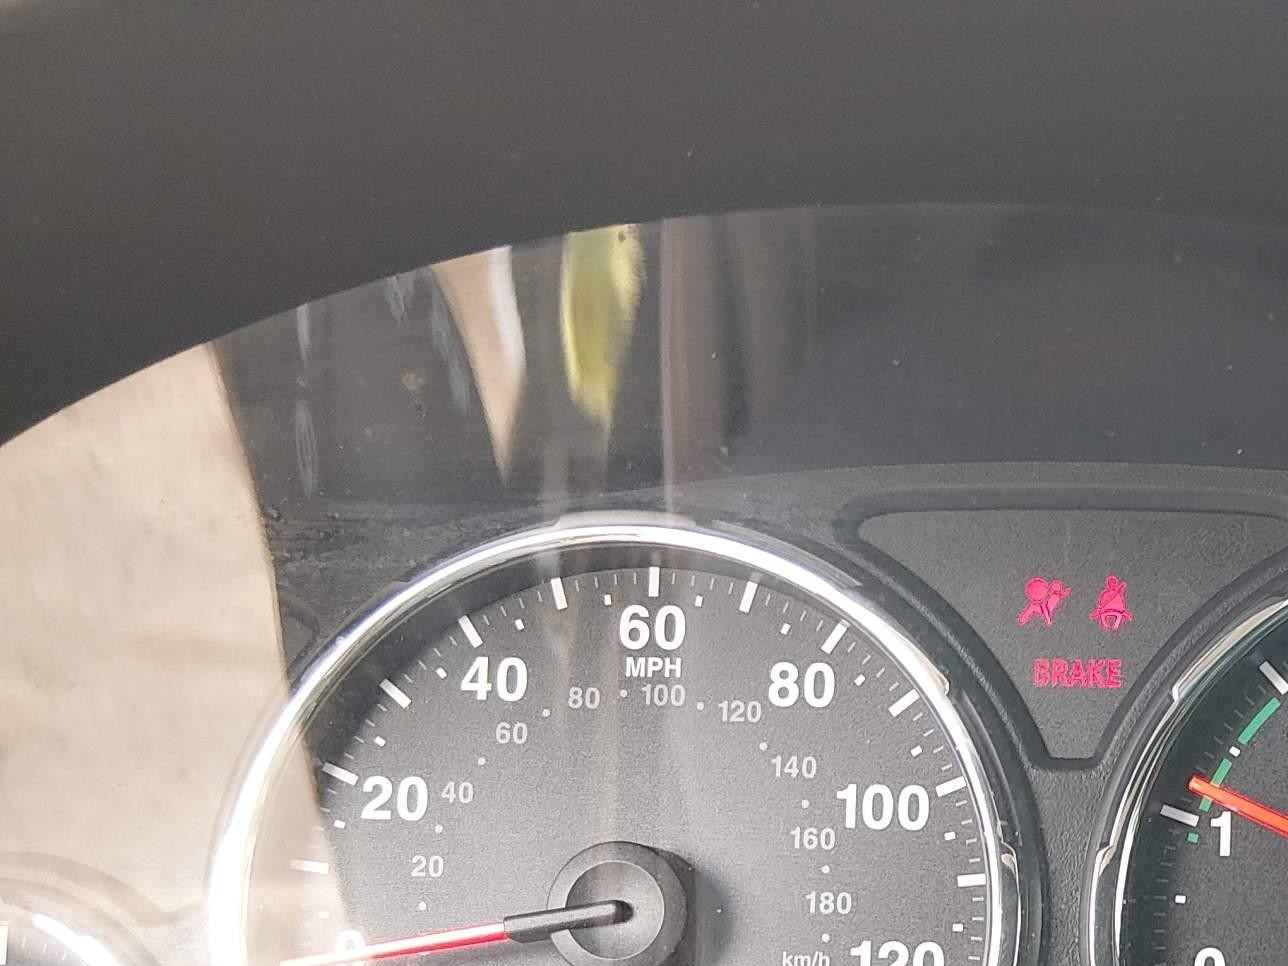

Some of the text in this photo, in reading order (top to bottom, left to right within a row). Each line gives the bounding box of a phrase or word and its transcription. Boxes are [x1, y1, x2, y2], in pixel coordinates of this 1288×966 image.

[619, 605, 686, 650] 60
[625, 657, 681, 678] MPH
[1033, 658, 1123, 688] BRAKE
[461, 657, 527, 702] 40
[769, 662, 835, 707] 80
[568, 687, 600, 709] 80
[641, 685, 686, 706] 100
[718, 701, 762, 723] 120
[496, 723, 528, 744] 60
[772, 756, 817, 778] 140
[361, 776, 428, 821] 20
[441, 782, 474, 803] 40
[837, 784, 930, 831] 100
[790, 828, 835, 849] 160
[1210, 814, 1231, 856] 1
[411, 856, 443, 878] 20
[806, 892, 852, 914] 180
